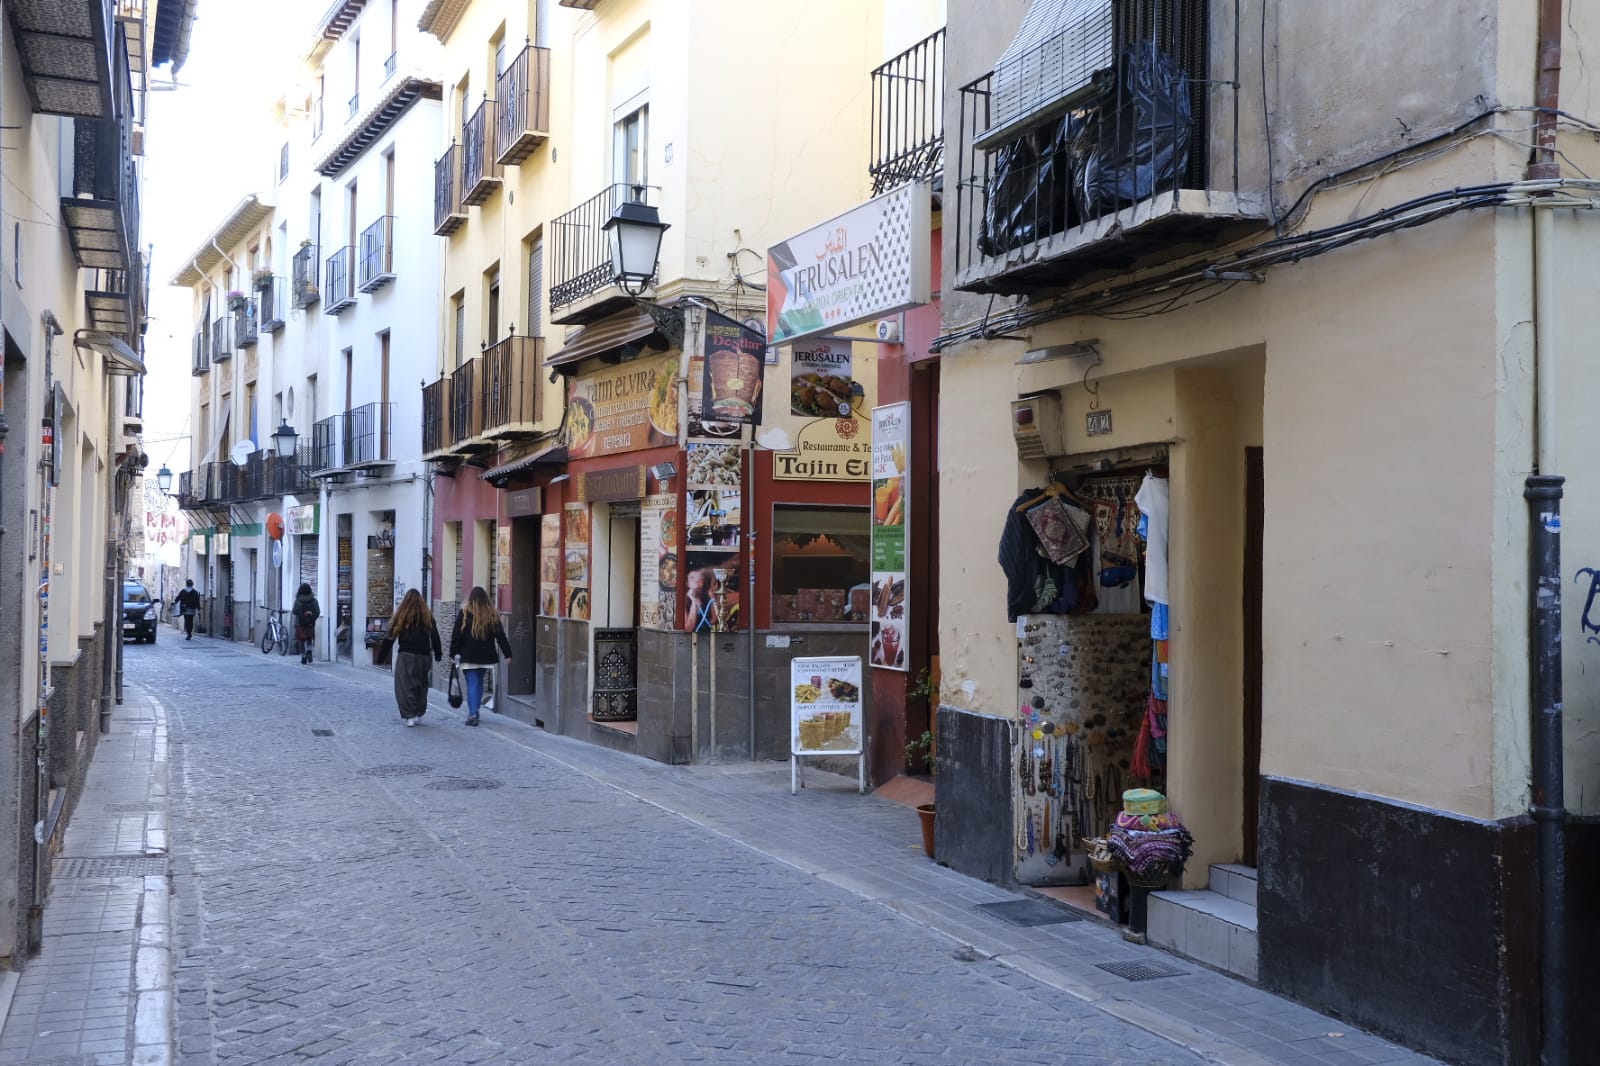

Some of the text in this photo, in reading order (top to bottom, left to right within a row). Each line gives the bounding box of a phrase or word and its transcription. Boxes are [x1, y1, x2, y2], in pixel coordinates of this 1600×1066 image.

[793, 242, 882, 303] JERUSALEN
[794, 351, 850, 364] JERUSALEN
[803, 441, 850, 452] Restaurante
[852, 443, 860, 452] &
[779, 457, 838, 477] Tajin
